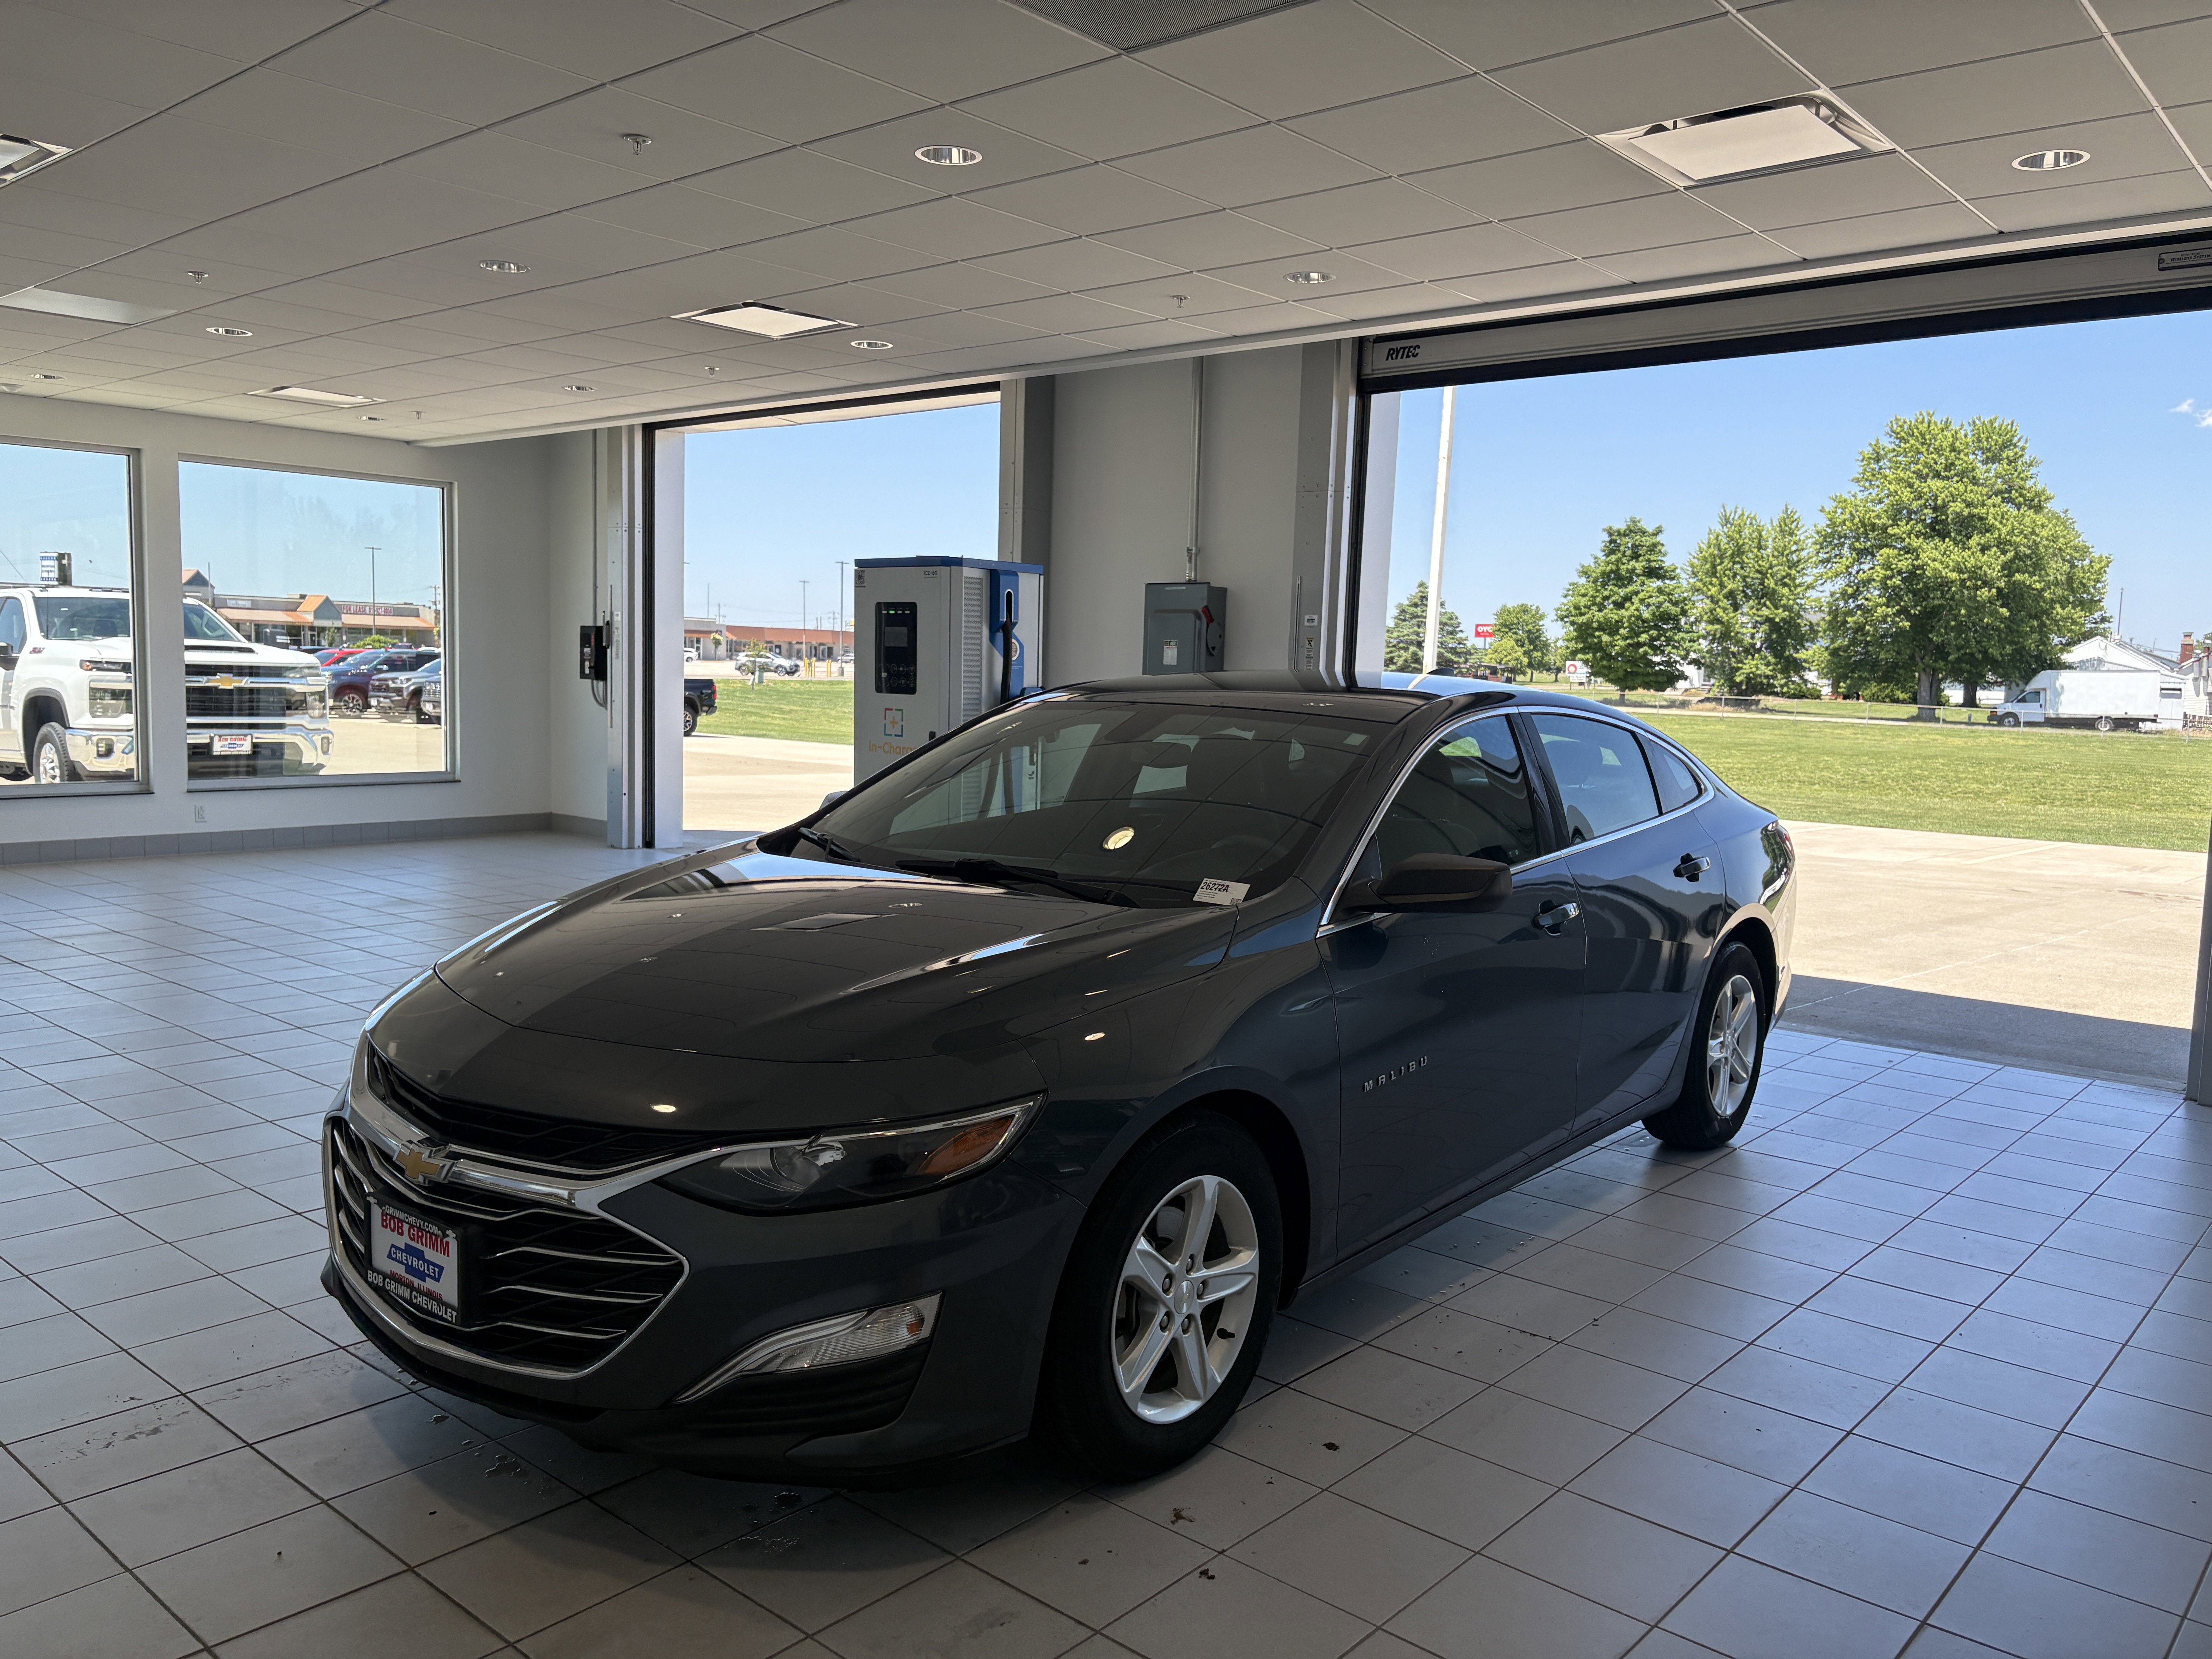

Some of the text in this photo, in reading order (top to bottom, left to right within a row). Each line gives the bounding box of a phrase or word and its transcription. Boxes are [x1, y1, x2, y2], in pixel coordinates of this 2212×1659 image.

[1386, 345, 1420, 361] RYTEC
[1201, 882, 1229, 893] 26272A
[1363, 1056, 1427, 1092] MALIBU
[381, 1211, 450, 1258] BOB GRIMM
[385, 1205, 439, 1235] GRIMMCHEVY.COM
[391, 1247, 439, 1278] CHEVROLET
[368, 1270, 457, 1324] BOB GRIMM CHEVROLET
